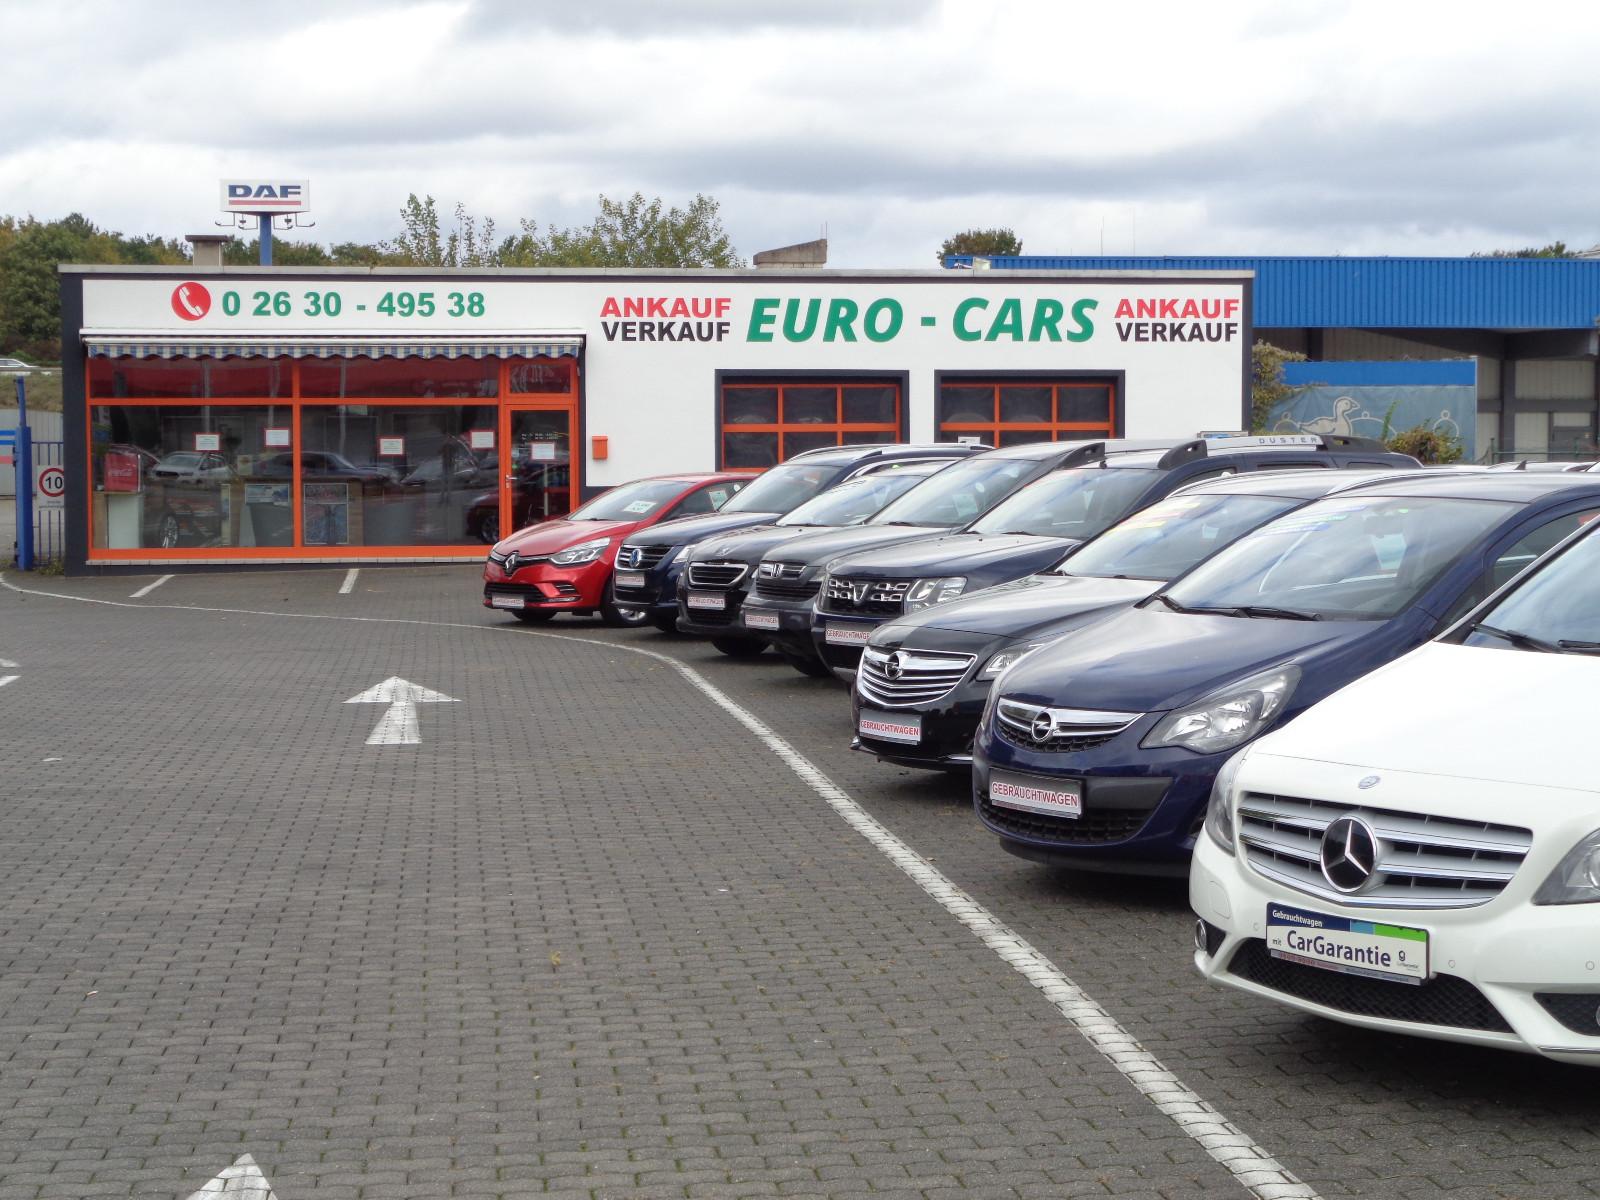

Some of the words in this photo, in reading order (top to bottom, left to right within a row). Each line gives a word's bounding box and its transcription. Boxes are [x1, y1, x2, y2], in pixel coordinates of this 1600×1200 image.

[228, 184, 302, 199] DAF
[222, 291, 241, 317] 0
[252, 291, 292, 317] 26
[303, 291, 342, 317] 30
[376, 292, 436, 317] 495
[447, 292, 486, 318] 38
[600, 296, 731, 318] ANKAUF
[1114, 298, 1240, 319] ANKAUF
[746, 297, 904, 343] EURO
[952, 297, 1099, 343] CARS
[601, 321, 731, 342] VERKAUF
[1115, 322, 1239, 342] VERKAUF
[1258, 436, 1318, 445] DUSTER
[45, 476, 63, 489] 10
[826, 628, 870, 640] GEBRAUCHTWAGE
[860, 719, 919, 736] GEBRAUCHTWAGEN
[992, 782, 1078, 807] GEBRAUCHTWAGEN
[1272, 909, 1323, 928] Gebrauchtwagen
[1272, 938, 1282, 947] mit
[1287, 930, 1391, 967] CarGarantie
